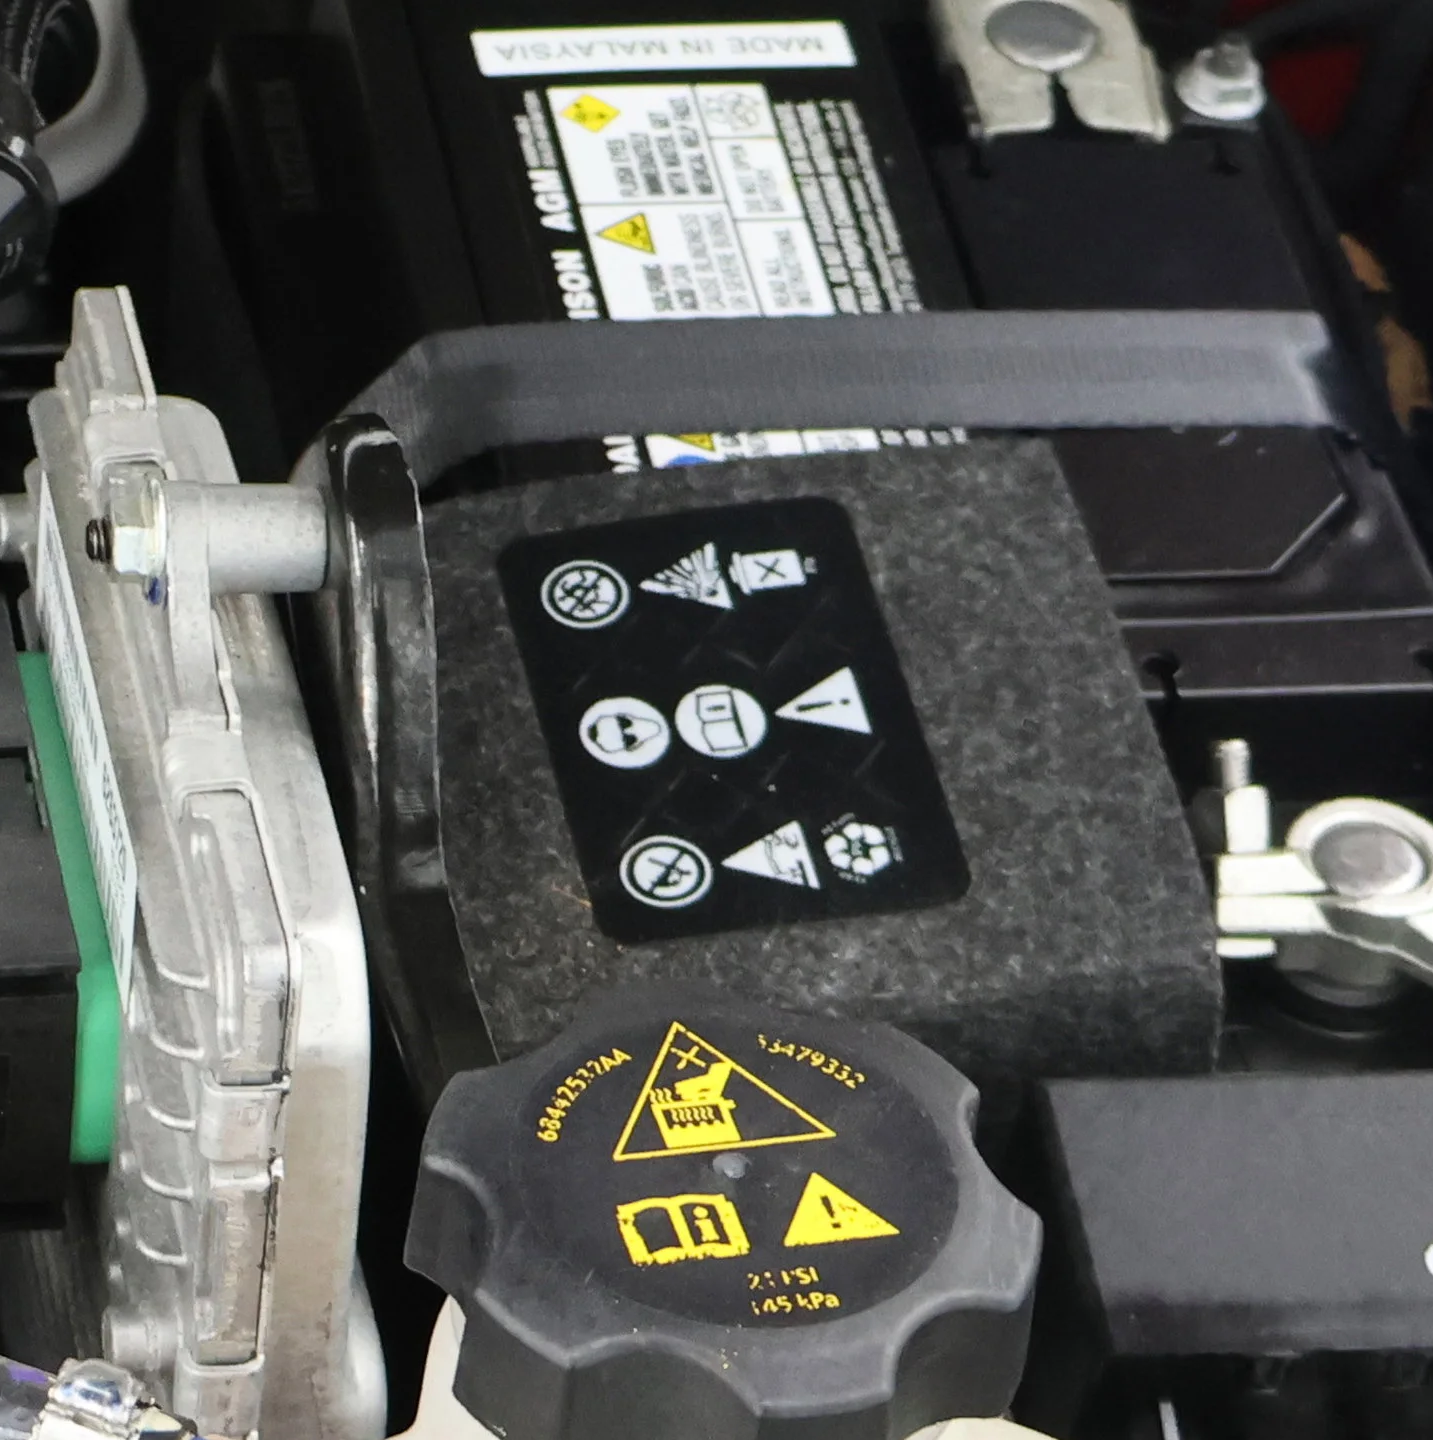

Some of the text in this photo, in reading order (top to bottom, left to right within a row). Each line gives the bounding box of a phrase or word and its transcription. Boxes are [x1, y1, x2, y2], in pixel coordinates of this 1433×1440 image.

[494, 36, 824, 60] MADE IN MALAYSIA
[529, 172, 577, 233] AGM
[780, 1266, 820, 1286] PSI
[795, 1290, 841, 1311] kPa
